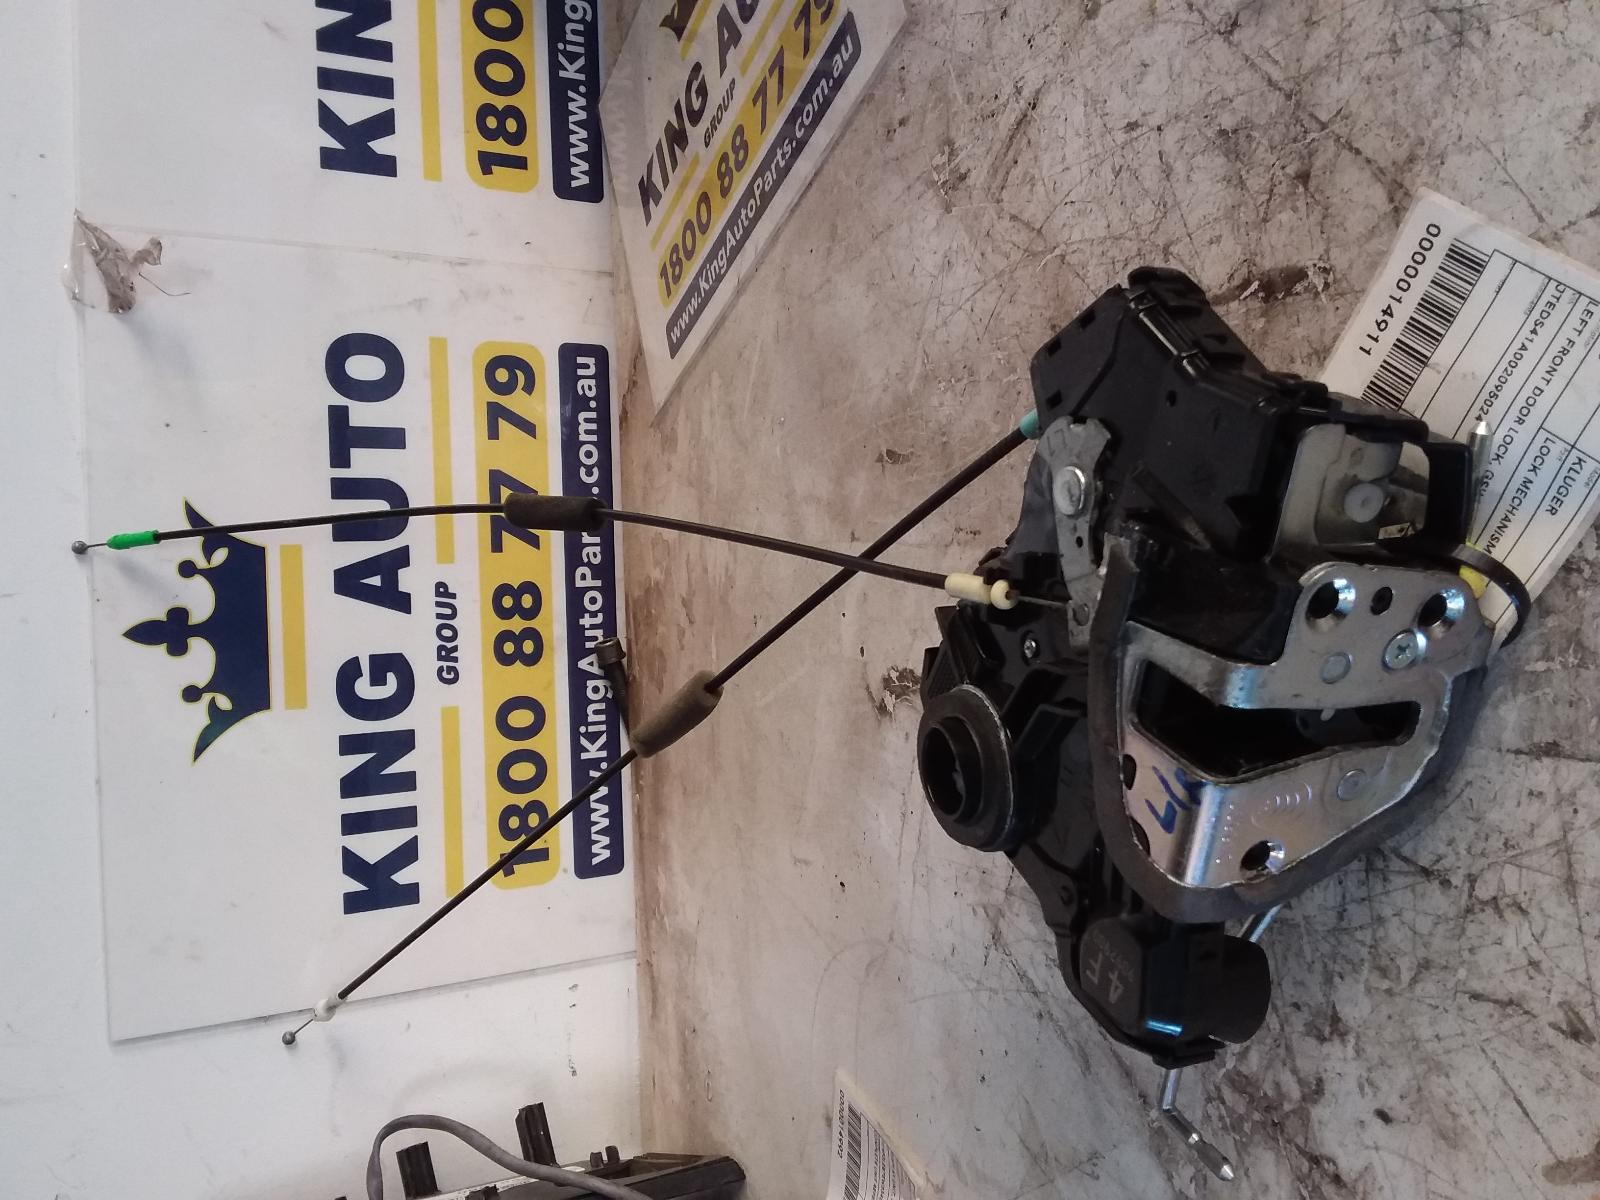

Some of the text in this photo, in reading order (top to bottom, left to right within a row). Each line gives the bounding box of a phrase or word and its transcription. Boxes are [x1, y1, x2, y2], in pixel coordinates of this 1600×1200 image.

[315, 0, 398, 177] KIN
[472, 0, 528, 175] 1800
[637, 61, 709, 227] KING
[704, 77, 736, 149] GROUP
[660, 191, 712, 299] 1800
[716, 123, 749, 200] 88
[752, 44, 785, 136] 77
[670, 33, 854, 344] www.KingAutoParts.com.au
[1358, 223, 1442, 356] 0000014911
[1540, 337, 1577, 388] FRONT
[1572, 299, 1600, 337] LEFT
[1513, 385, 1545, 426] DOOR
[1482, 436, 1557, 555] LOCK MECHANISM
[1545, 455, 1588, 517] KLUGER
[325, 332, 420, 915] KING AUTO
[434, 580, 460, 686] GROUP
[484, 354, 550, 878] 1800 88 77 79
[575, 355, 614, 866] www.KingAutoPar.com.au
